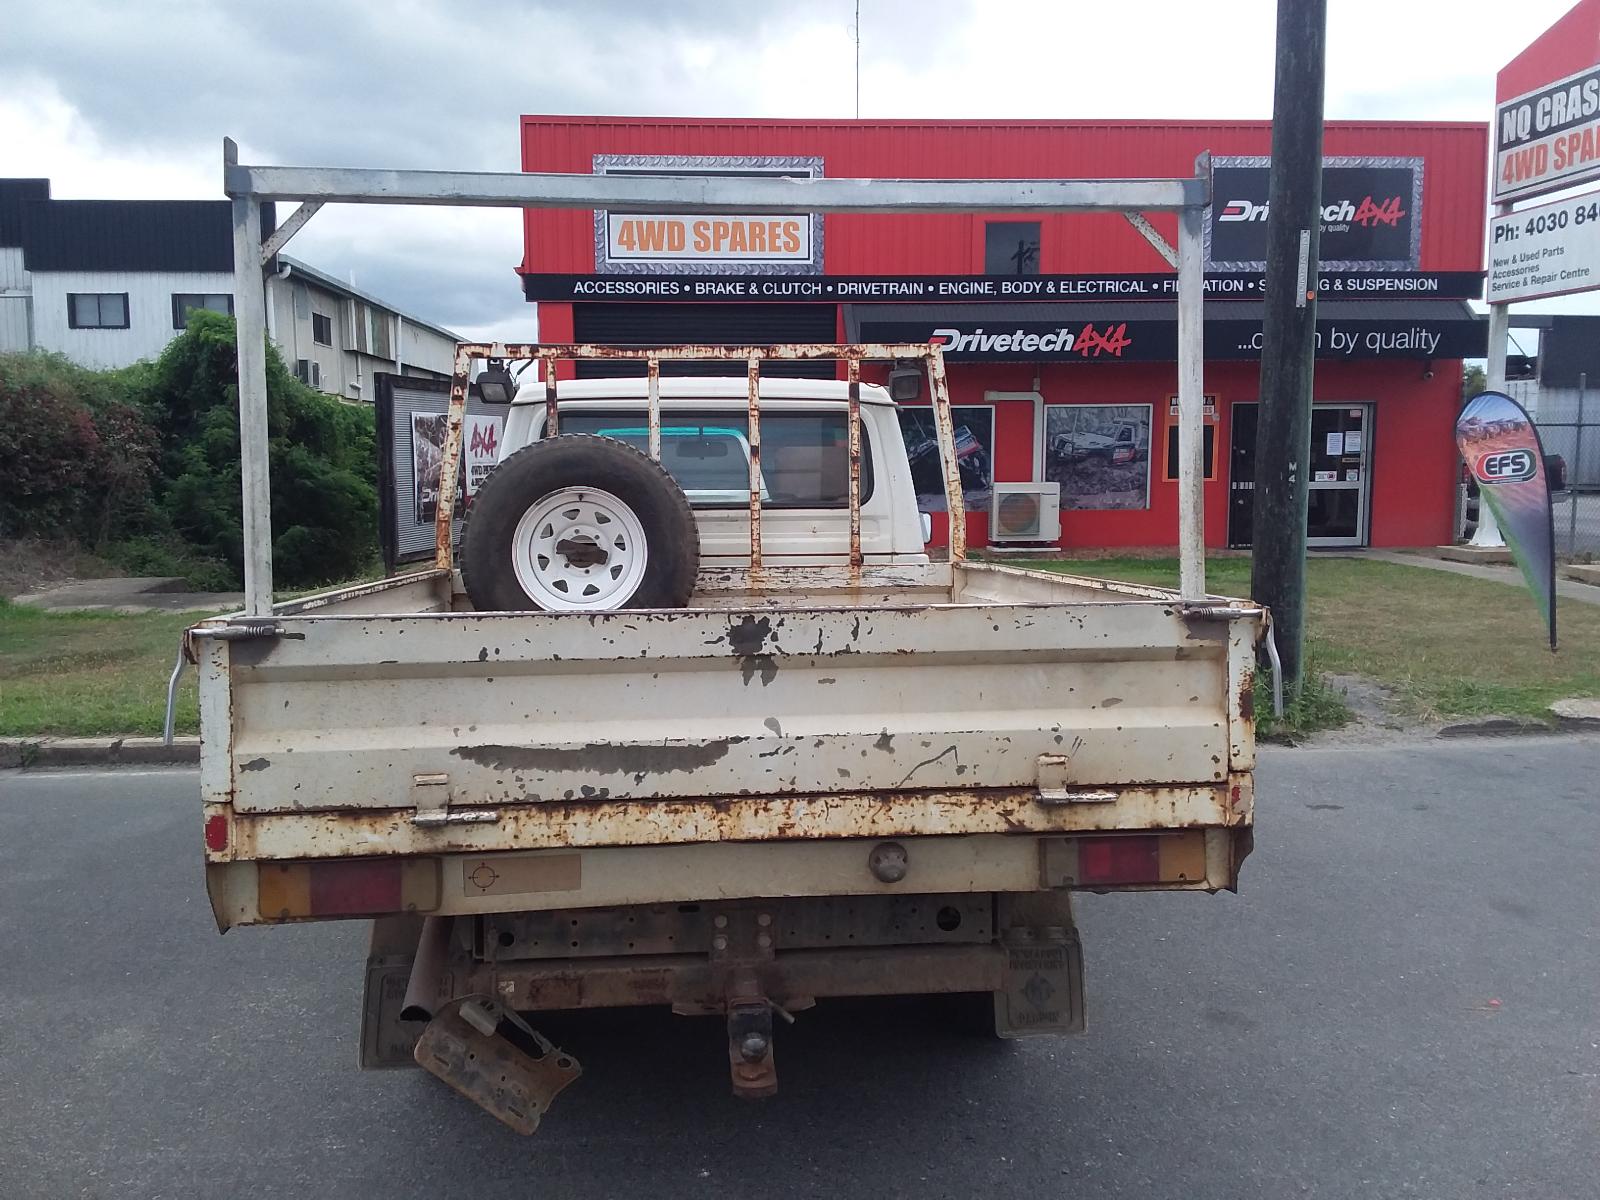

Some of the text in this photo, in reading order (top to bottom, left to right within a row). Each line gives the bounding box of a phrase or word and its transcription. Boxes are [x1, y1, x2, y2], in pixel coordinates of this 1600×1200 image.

[1503, 78, 1600, 144] NQ CRAS
[1502, 143, 1548, 185] 4WD
[1328, 224, 1350, 232] quality
[1494, 202, 1600, 244] Ph: 4030 84
[618, 220, 800, 252] 4WD SPARES
[1493, 246, 1564, 268] New & Used Parts
[1492, 267, 1590, 292] Service & Repair Centre
[1493, 264, 1540, 280] Accessories
[573, 281, 679, 294] ACCESSORIES
[695, 282, 745, 295] BRAKE
[749, 282, 759, 295] &
[762, 282, 822, 295] CLUTCH
[837, 282, 923, 295] DRIVETRAIN
[939, 281, 997, 296] ENGINE,
[1001, 281, 1043, 294] BODY
[1046, 281, 1056, 294] &
[1060, 280, 1148, 293] ELECTRICAL
[1333, 279, 1343, 291] &
[1347, 278, 1438, 291] SUSPENSION
[928, 328, 1075, 352] Drivetech
[1330, 327, 1359, 354] by
[1366, 327, 1441, 354] quality
[1289, 462, 1297, 471] M
[1485, 454, 1526, 475] EFS
[1289, 474, 1296, 483] 4
